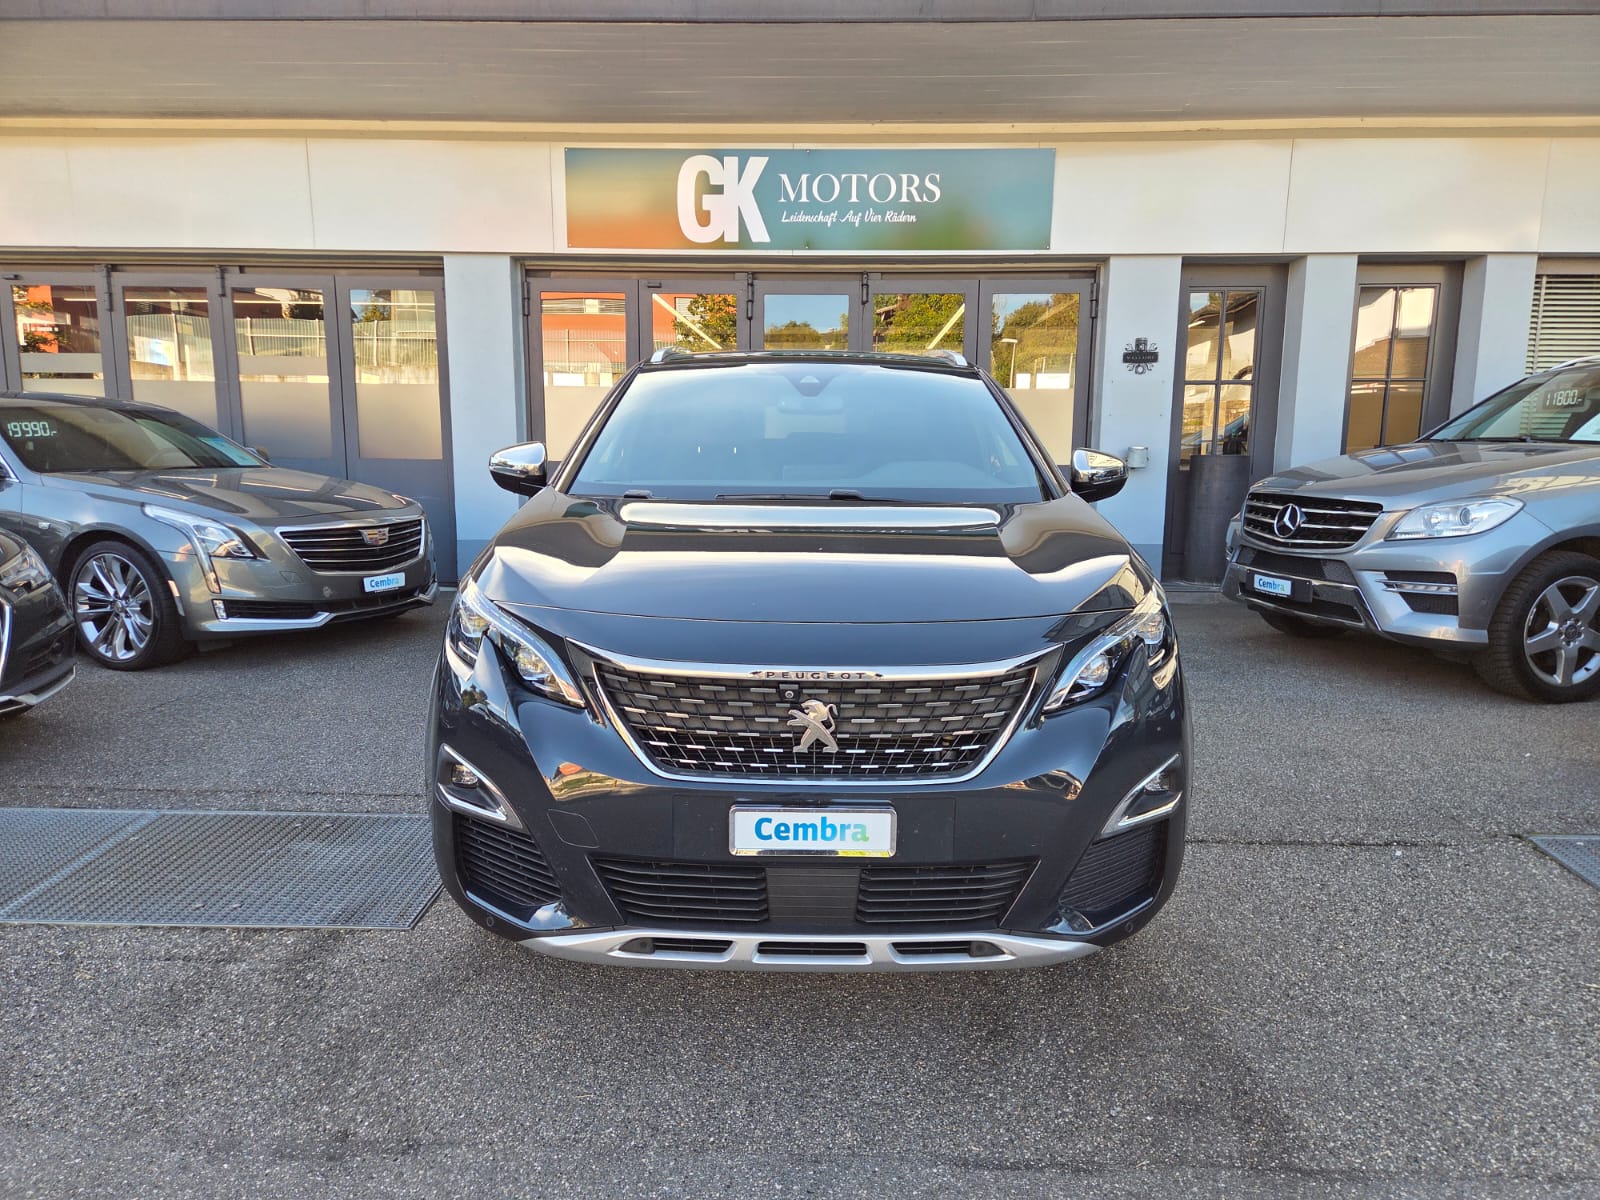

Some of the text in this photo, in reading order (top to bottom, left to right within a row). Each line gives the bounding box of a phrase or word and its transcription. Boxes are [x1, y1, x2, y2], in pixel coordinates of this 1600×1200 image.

[677, 154, 941, 243] GK MOTORS
[781, 207, 917, 227] Leidenschaft Auf Vier Rädern
[370, 576, 399, 588] Cembra
[1258, 578, 1285, 592] Cembra
[766, 671, 866, 680] PEUGEOT
[754, 816, 869, 842] Cembra
